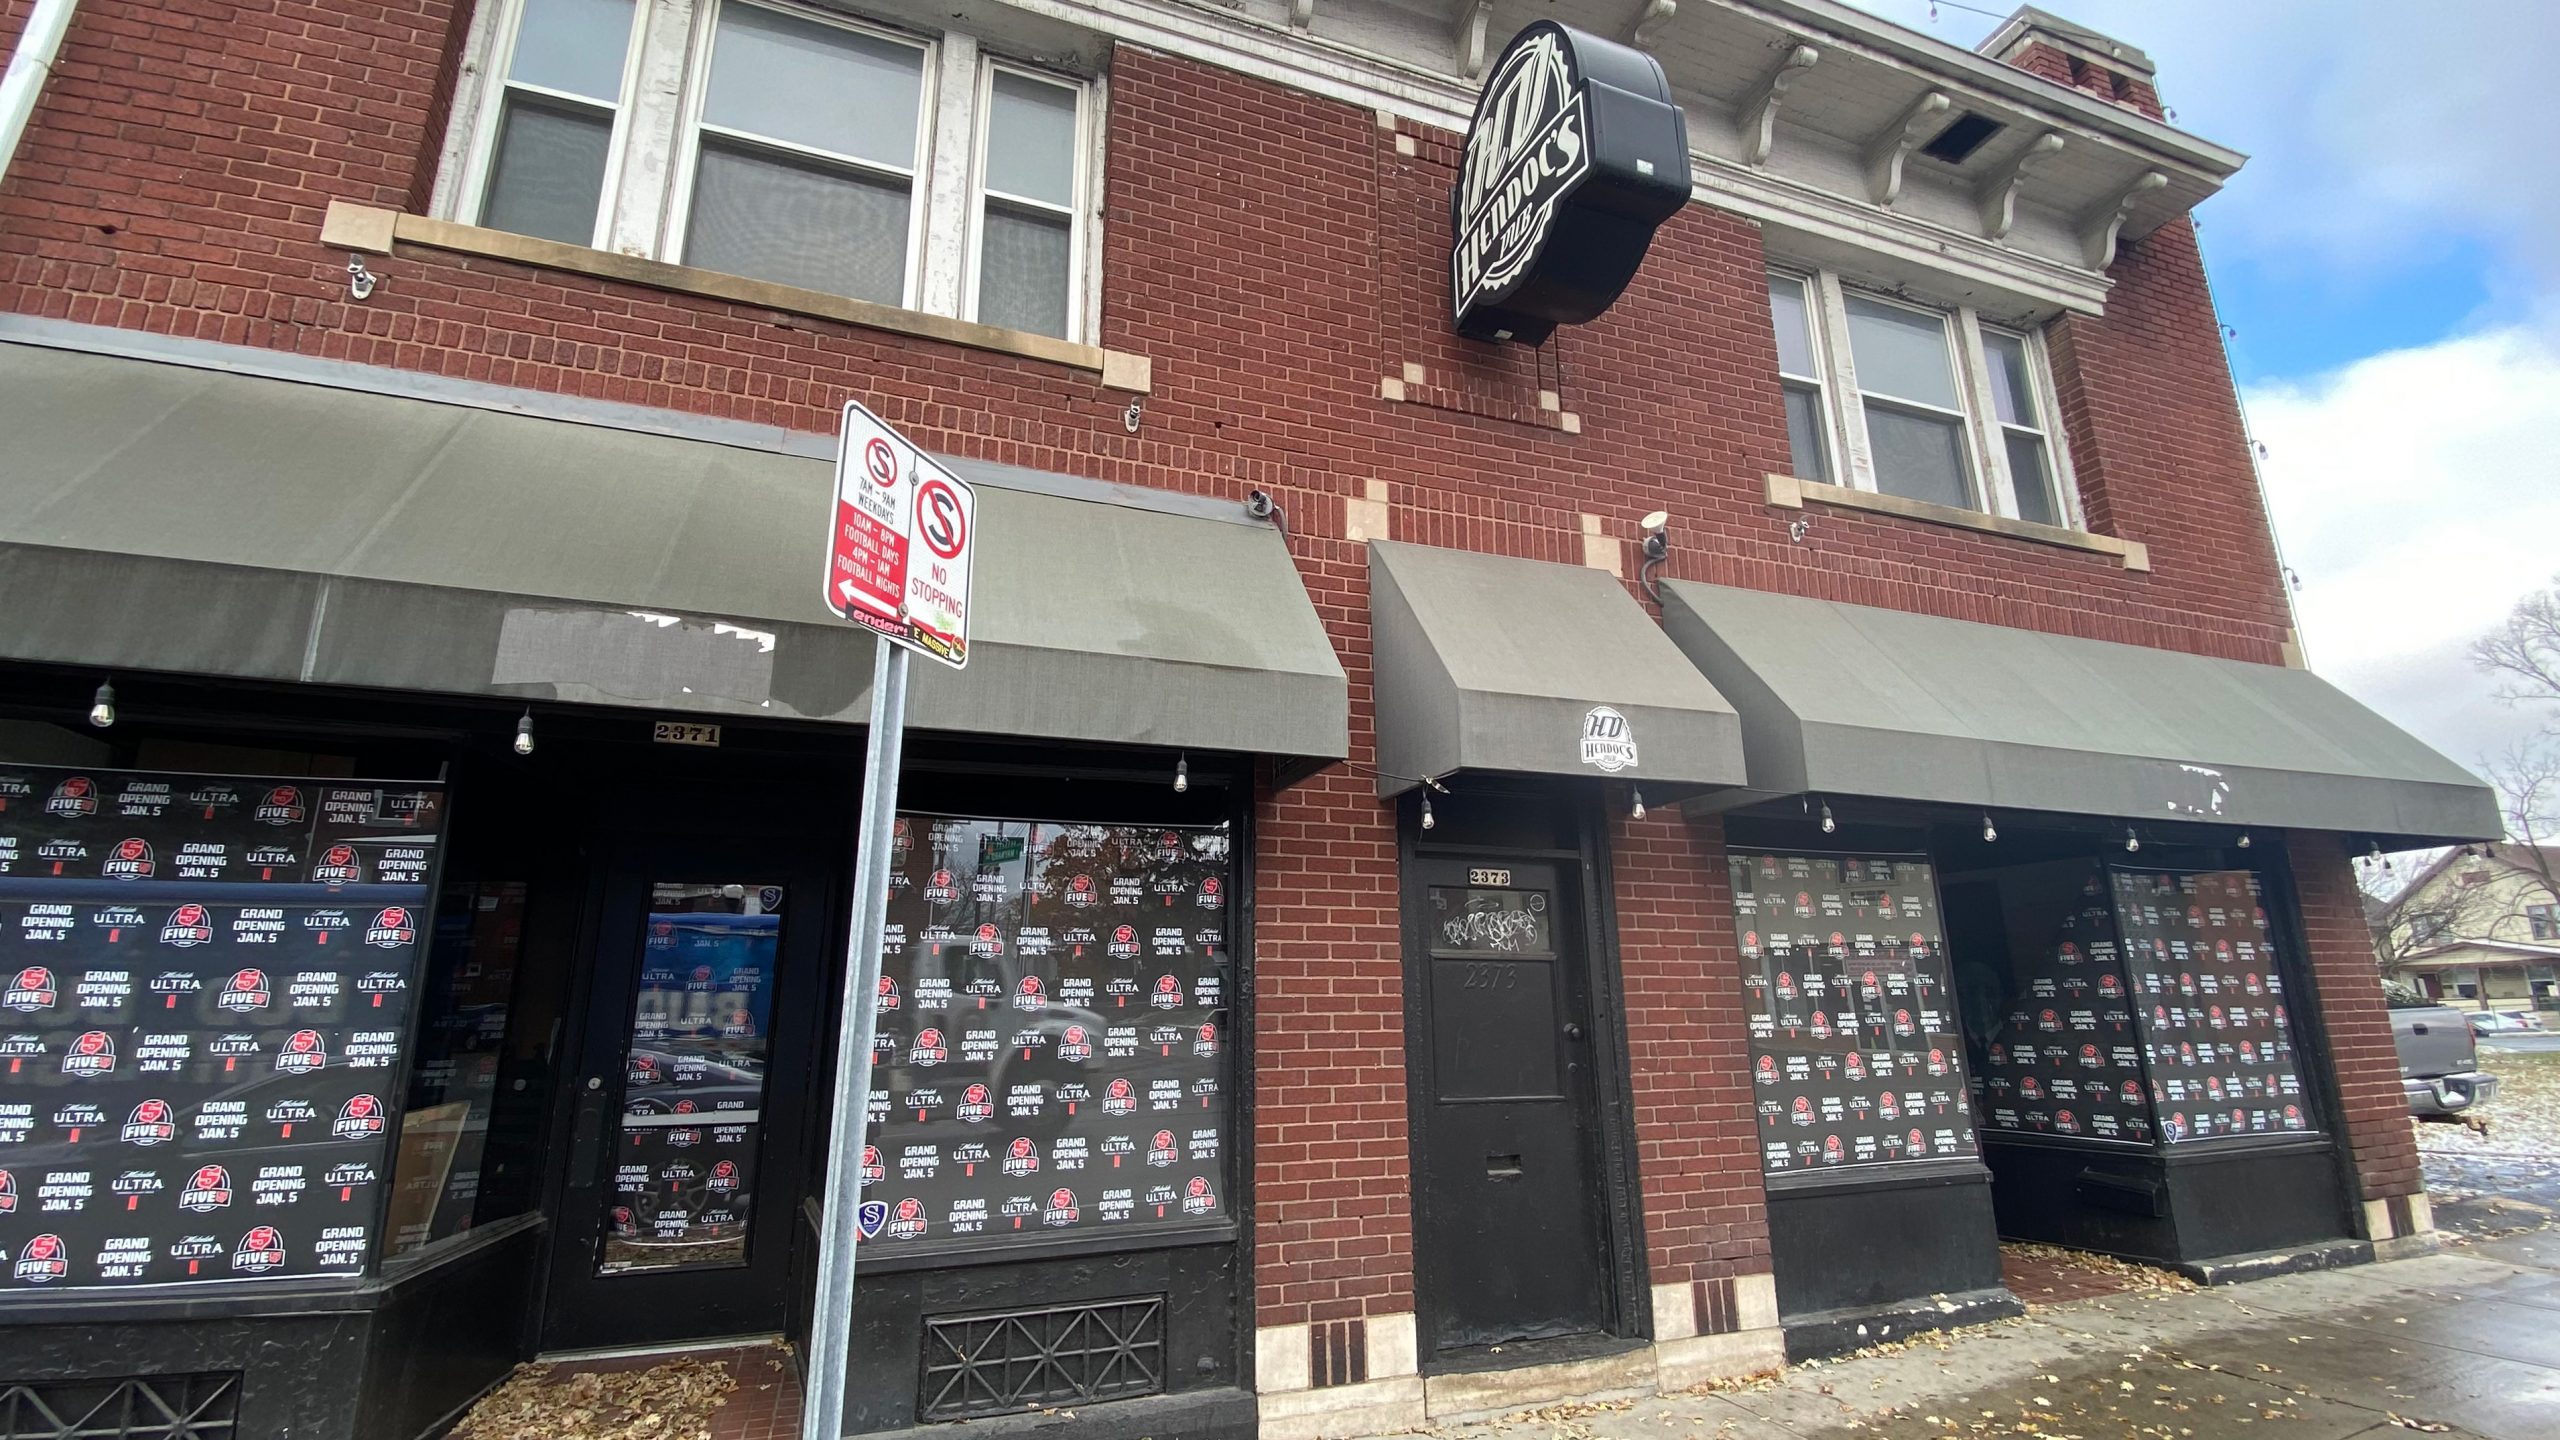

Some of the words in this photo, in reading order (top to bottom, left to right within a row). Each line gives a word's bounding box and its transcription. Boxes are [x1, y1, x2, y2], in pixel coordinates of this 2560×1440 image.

[859, 476, 873, 497] 7AM
[882, 491, 896, 510] 9AM
[858, 492, 894, 525] WEEKDAYS
[853, 512, 872, 533] 10AM
[880, 528, 895, 547] 8PM
[844, 524, 880, 555] FOOTBALL
[881, 545, 900, 566] DAYS
[852, 546, 869, 565] 4PM
[877, 558, 890, 577] 1AM
[838, 554, 873, 585] FOOTBALL
[875, 575, 900, 599] NIGHTS
[931, 562, 947, 586] NO
[911, 577, 963, 618] STOPPING
[921, 632, 950, 659] MASSIVE
[656, 724, 718, 743] 2371
[128, 783, 169, 792] GRAND
[118, 794, 170, 804] OPENING
[190, 793, 238, 802] ULTRA
[122, 805, 149, 815] JAN.
[153, 807, 161, 816] 5
[38, 847, 88, 856] ULTRA
[183, 843, 225, 854] GRAND
[175, 855, 227, 866] OPENING
[106, 862, 137, 873] FIVE
[179, 867, 207, 877] JAN.
[210, 868, 219, 877] 5
[977, 875, 1004, 883] GRAND
[1470, 870, 1509, 884] 2373
[927, 888, 948, 898] FIVE
[973, 884, 1007, 893] OPENING
[997, 894, 1002, 902] 5
[29, 904, 72, 915] GRAND
[21, 917, 74, 927] OPENING
[304, 917, 350, 926] ULTRA
[25, 929, 54, 940] JAN.
[56, 930, 65, 940] 5
[1156, 928, 1182, 936] GRAND
[1152, 937, 1185, 945] OPENING
[1156, 947, 1174, 955] JAN.
[1176, 947, 1181, 955] 5
[297, 972, 337, 982] GRAND
[1464, 961, 1517, 990] 2373
[150, 980, 202, 989] ULTRA
[919, 979, 949, 987] GRAND
[1064, 978, 1091, 987] GRAND
[289, 984, 339, 994] OPENING
[915, 989, 952, 998] OPENING
[966, 985, 1001, 993] ULTRA
[1060, 988, 1094, 997] OPENING
[222, 995, 254, 1006] FIVE
[293, 997, 320, 1006] JAN.
[323, 996, 331, 1006] 5
[918, 1000, 939, 1008] JAN.
[941, 999, 947, 1008] 5
[1015, 995, 1035, 1005] FIVE
[1063, 999, 1082, 1007] JAN.
[1084, 998, 1089, 1006] 5
[144, 1035, 188, 1045] GRAND
[1012, 1036, 1046, 1044] ULTRA
[210, 1042, 260, 1052] ULTRA
[136, 1047, 190, 1058] OPENING
[66, 1057, 99, 1069] FIVE
[140, 1060, 169, 1071] JAN.
[172, 1060, 181, 1071] 5
[1012, 1085, 1041, 1095] GRAND
[905, 1095, 943, 1105] ULTRA
[1007, 1095, 1043, 1105] OPENING
[1105, 1099, 1125, 1109] FIVE
[202, 1102, 245, 1113] GRAND
[960, 1106, 982, 1116] FIVE
[1011, 1106, 1031, 1116] JAN.
[1033, 1106, 1039, 1115] 5
[1759, 1105, 1783, 1113] ULTRA
[53, 1112, 106, 1123] ULTRA
[195, 1114, 248, 1126] OPENING
[337, 1119, 369, 1131] FIVE
[199, 1128, 227, 1139] JAN.
[230, 1127, 239, 1138] 5
[1193, 1129, 1216, 1139] GRAND
[1101, 1142, 1136, 1152] ULTRA
[1189, 1139, 1219, 1149] OPENING
[905, 1145, 936, 1156] GRAND
[1193, 1150, 1208, 1159] JAN.
[1210, 1149, 1215, 1157] 5
[900, 1156, 939, 1167] OPENING
[619, 1165, 648, 1173] GRAND
[662, 1170, 694, 1178] ULTRA
[904, 1168, 925, 1179] JAN.
[927, 1168, 934, 1177] 5
[46, 1172, 90, 1183] GRAND
[325, 1170, 376, 1183] ULTRA
[615, 1174, 649, 1182] OPENING
[38, 1185, 92, 1197] OPENING
[638, 1184, 644, 1192] 5
[42, 1199, 72, 1211] JAN.
[74, 1199, 84, 1210] 5
[954, 1199, 985, 1210] GRAND
[1002, 1203, 1038, 1213] ULTRA
[659, 1210, 687, 1219] GRAND
[701, 1214, 734, 1223] ULTRA
[949, 1210, 988, 1222] OPENING
[1046, 1211, 1068, 1221] FIVE
[655, 1220, 690, 1228] OPENING
[953, 1222, 974, 1232] JAN.
[976, 1222, 982, 1230] 5
[322, 1227, 364, 1239] GRAND
[678, 1229, 683, 1237] 5
[170, 1243, 224, 1255] ULTRA
[315, 1239, 366, 1252] OPENING
[236, 1252, 269, 1265] FIVE
[320, 1253, 347, 1265] JAN.
[350, 1252, 358, 1264] 5
